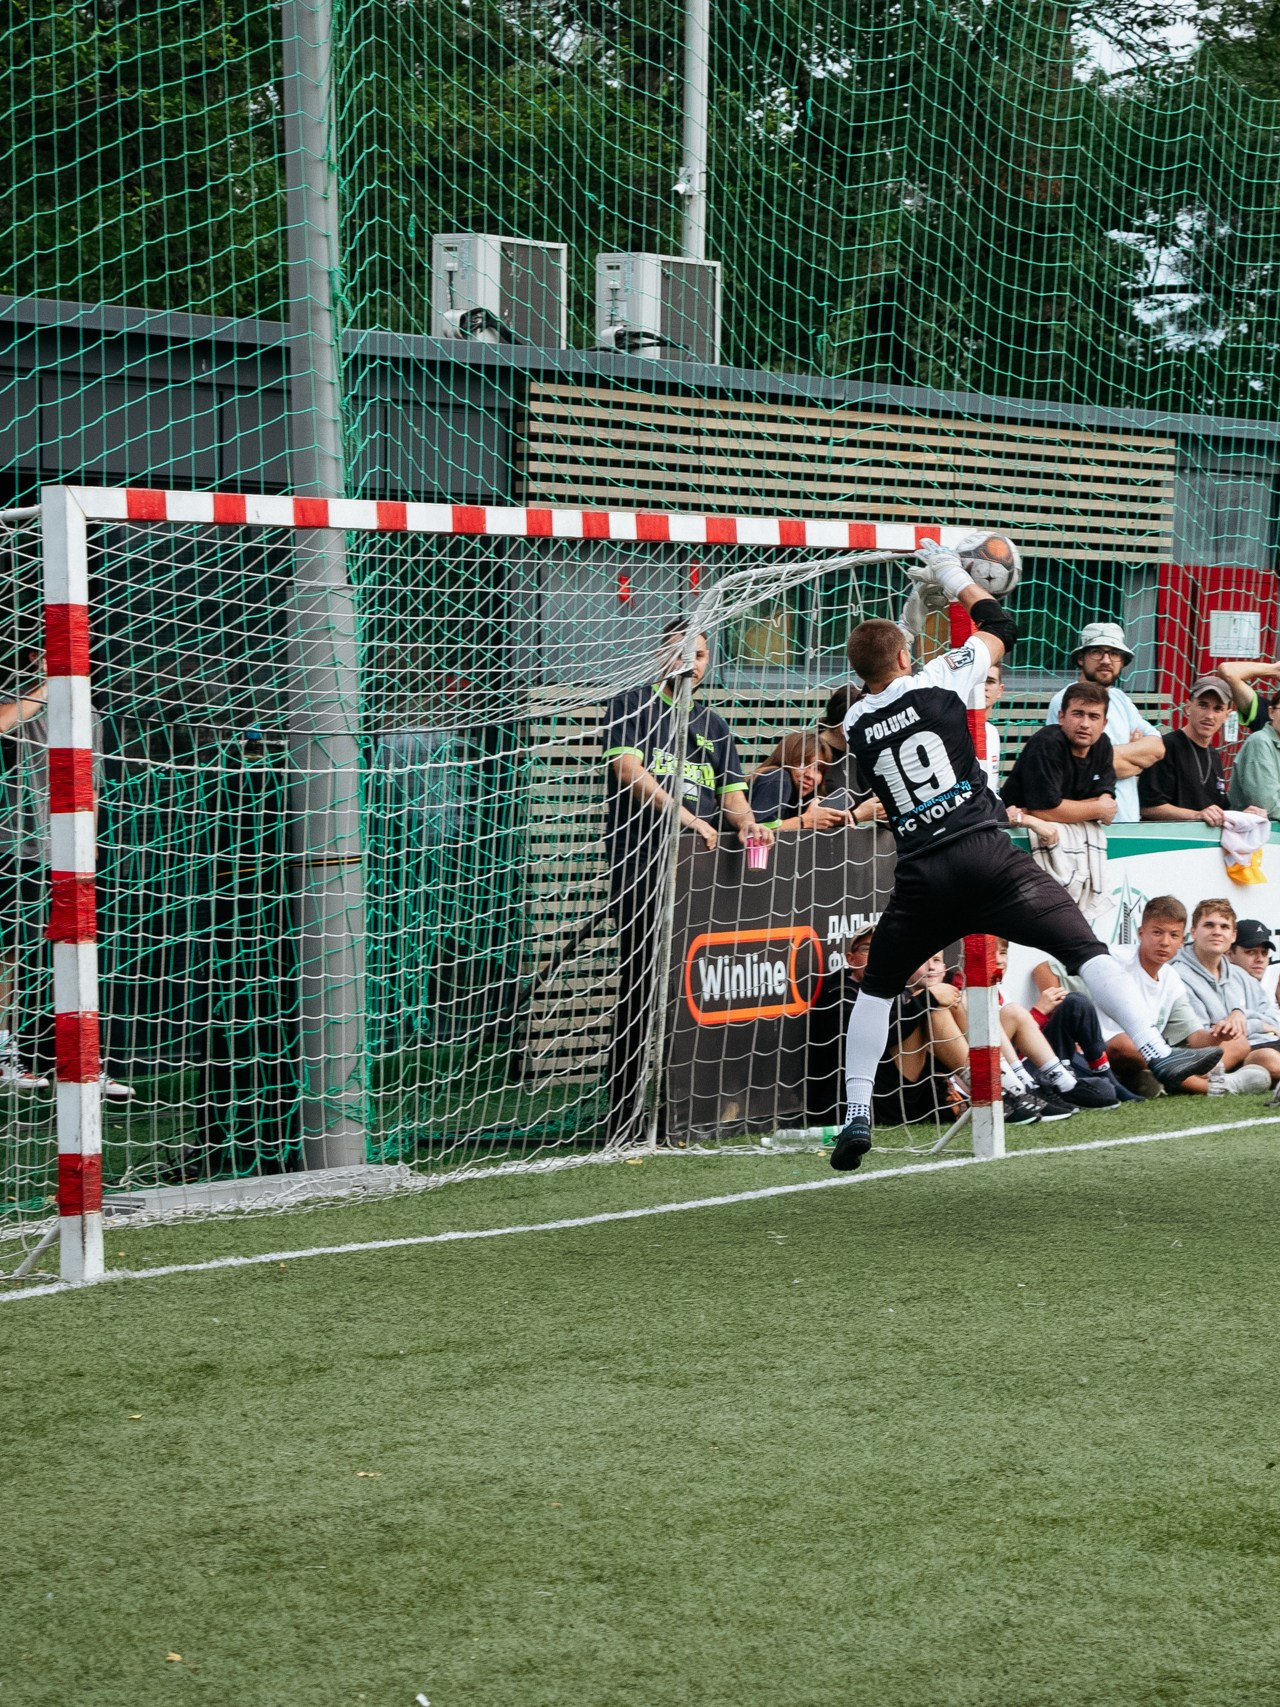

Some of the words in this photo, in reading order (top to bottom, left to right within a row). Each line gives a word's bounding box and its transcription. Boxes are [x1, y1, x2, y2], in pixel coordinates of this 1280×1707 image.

[864, 706, 921, 744] POLUKA
[873, 730, 957, 815] 19
[897, 818, 918, 837] FC
[919, 791, 973, 824] VOLAT
[698, 952, 788, 1002] Winline
